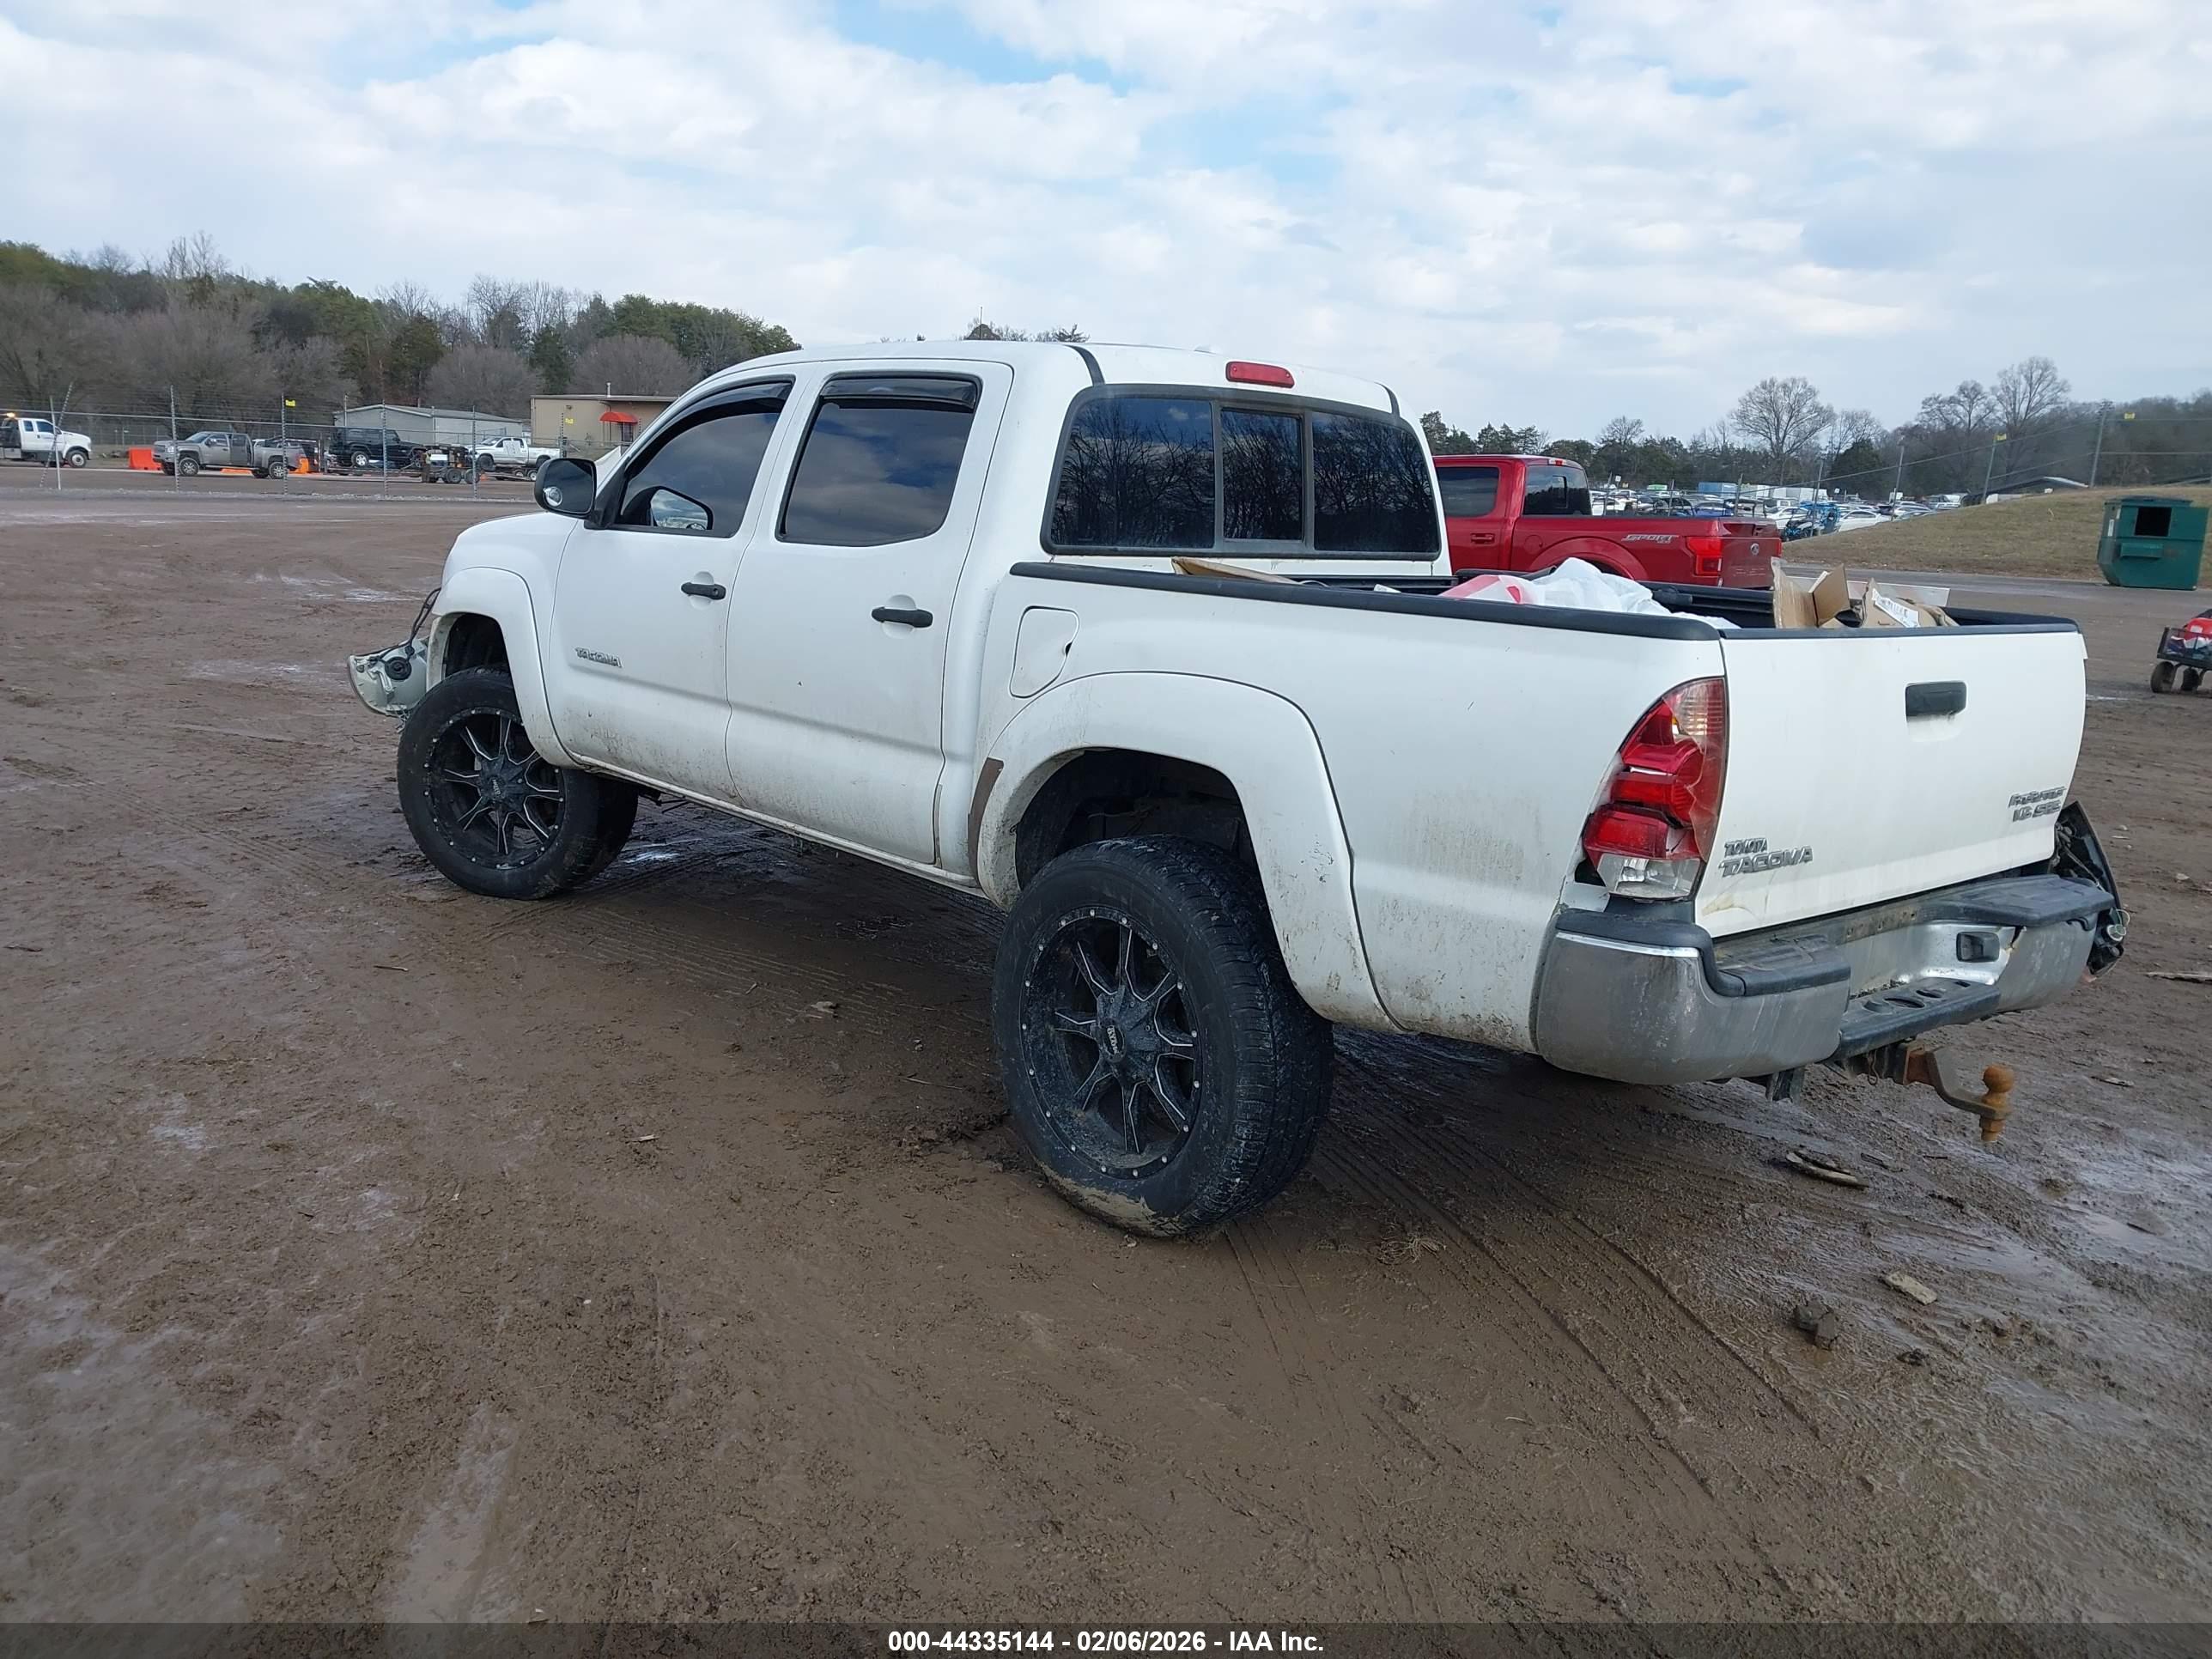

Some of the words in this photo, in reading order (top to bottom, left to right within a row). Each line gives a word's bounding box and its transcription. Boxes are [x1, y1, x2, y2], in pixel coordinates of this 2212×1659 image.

[1621, 533, 1679, 542] SPORT
[1724, 837, 1768, 858] TOYOTA
[1718, 846, 1814, 878] TACOMA
